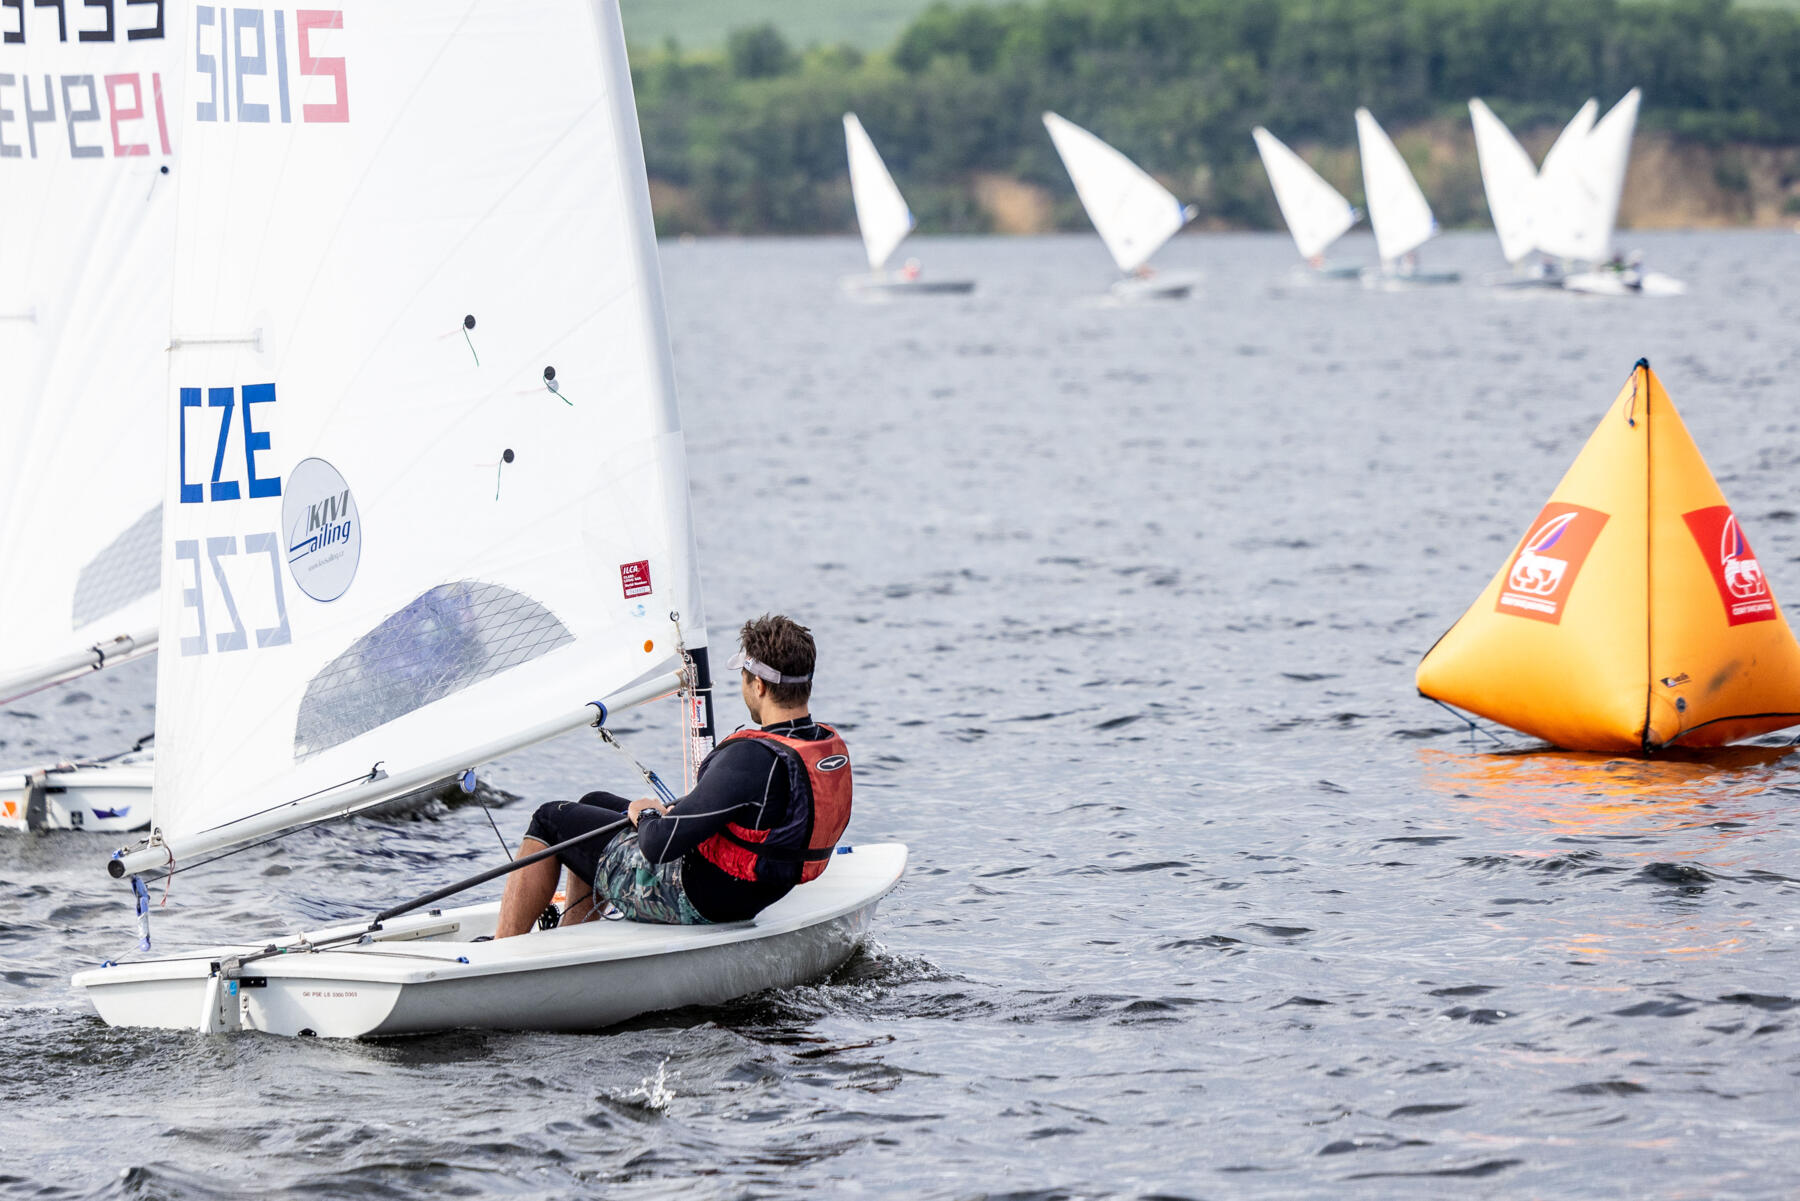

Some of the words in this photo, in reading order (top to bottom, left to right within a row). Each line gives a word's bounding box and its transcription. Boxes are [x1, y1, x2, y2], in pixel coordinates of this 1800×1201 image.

[179, 382, 282, 504] CZE
[309, 489, 350, 532] KIVI
[623, 565, 638, 574] ILCA
